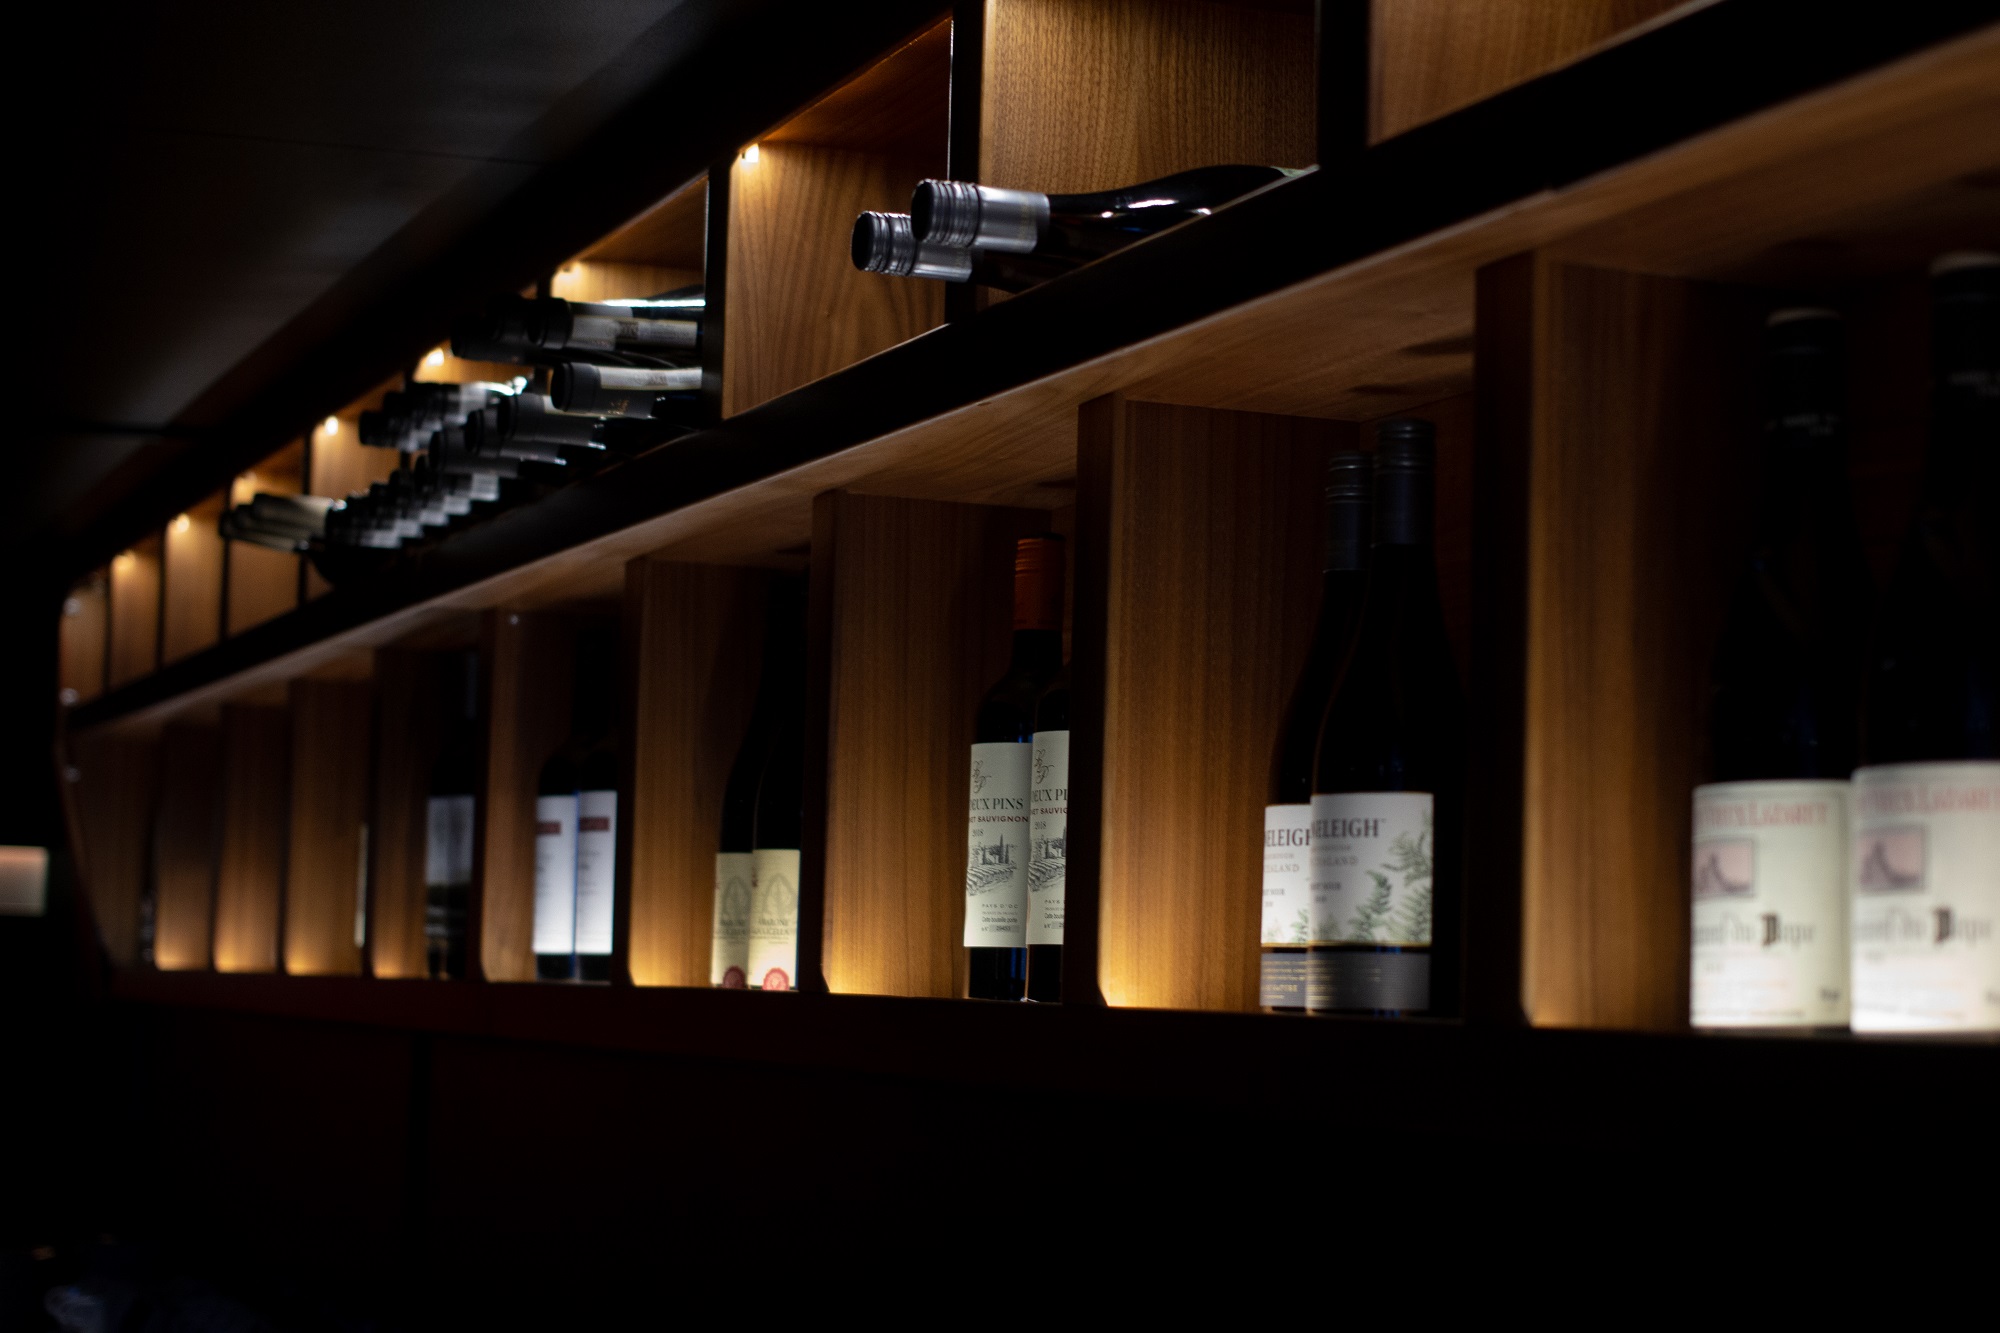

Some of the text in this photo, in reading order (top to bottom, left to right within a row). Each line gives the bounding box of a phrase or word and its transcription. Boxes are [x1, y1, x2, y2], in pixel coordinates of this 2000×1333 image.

[1055, 789, 1068, 801] PI
[993, 798, 1024, 810] PINS
[978, 815, 1029, 823] SAUVIGNON
